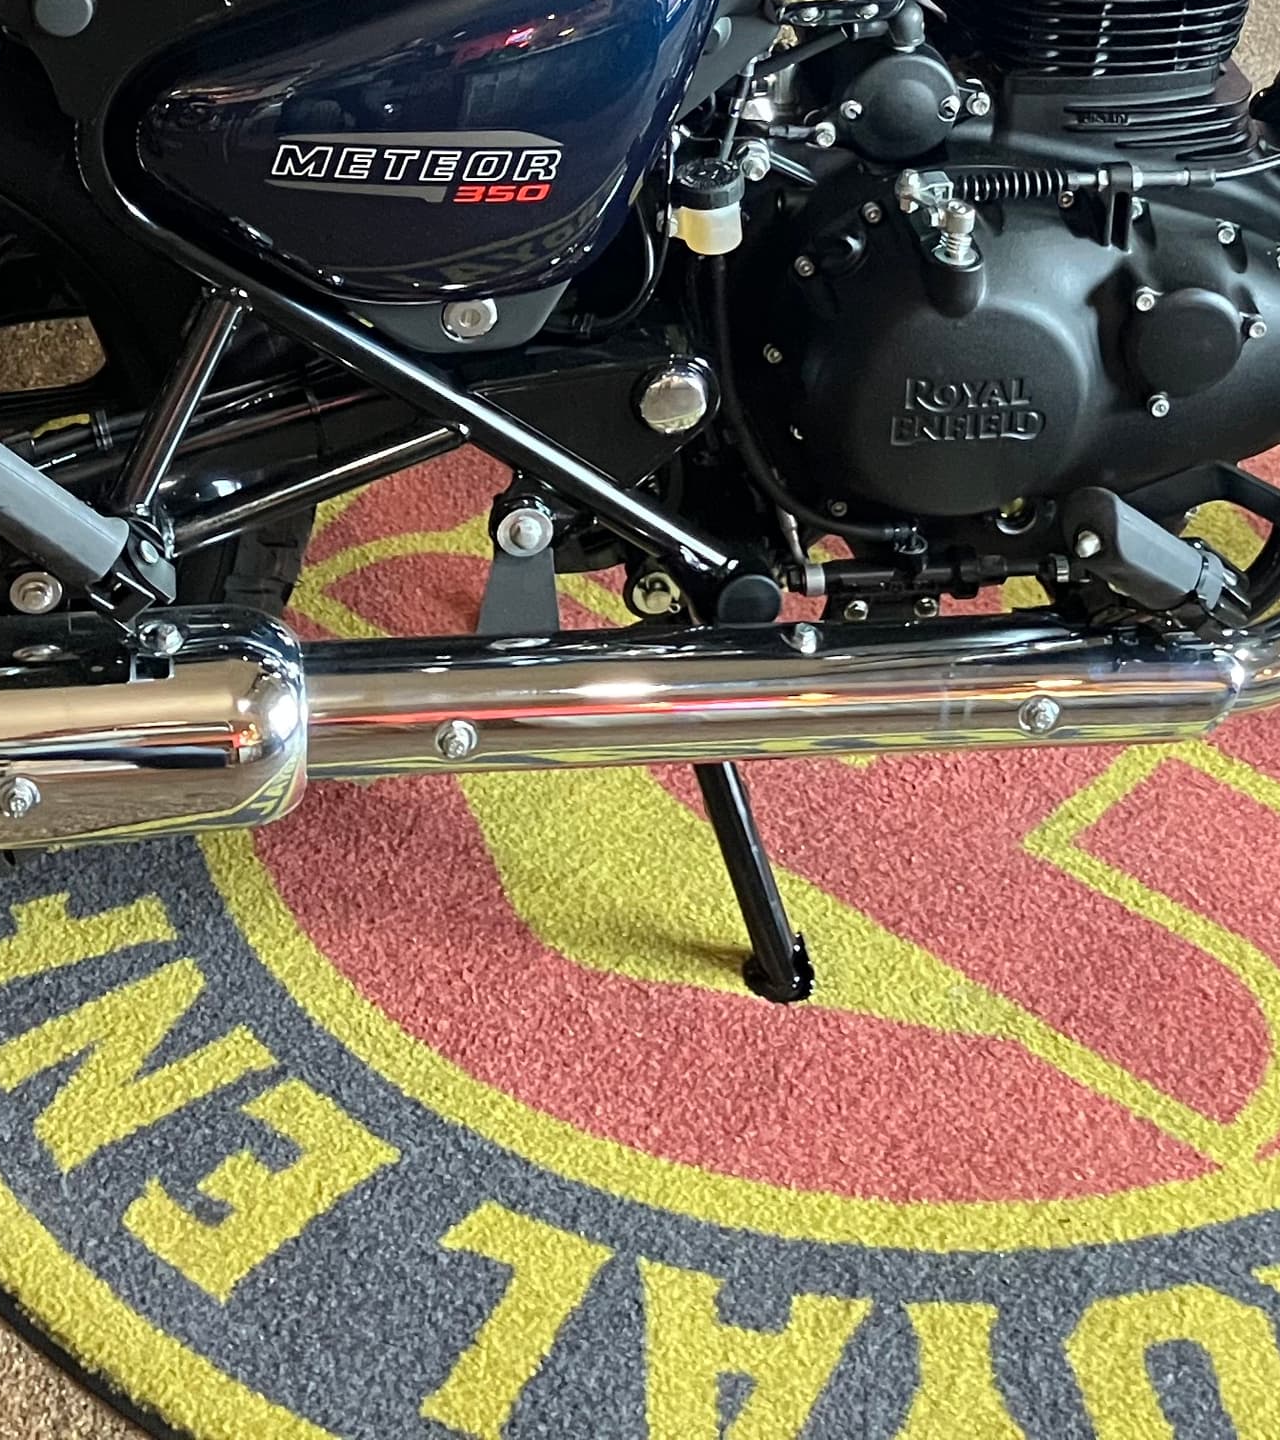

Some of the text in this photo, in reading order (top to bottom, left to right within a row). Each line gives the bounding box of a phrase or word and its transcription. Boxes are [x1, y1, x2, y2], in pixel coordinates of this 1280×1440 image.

[271, 144, 562, 182] METEOR
[452, 183, 552, 203] 350
[905, 377, 1032, 413] ROYAL
[891, 411, 1046, 446] ENFIELD
